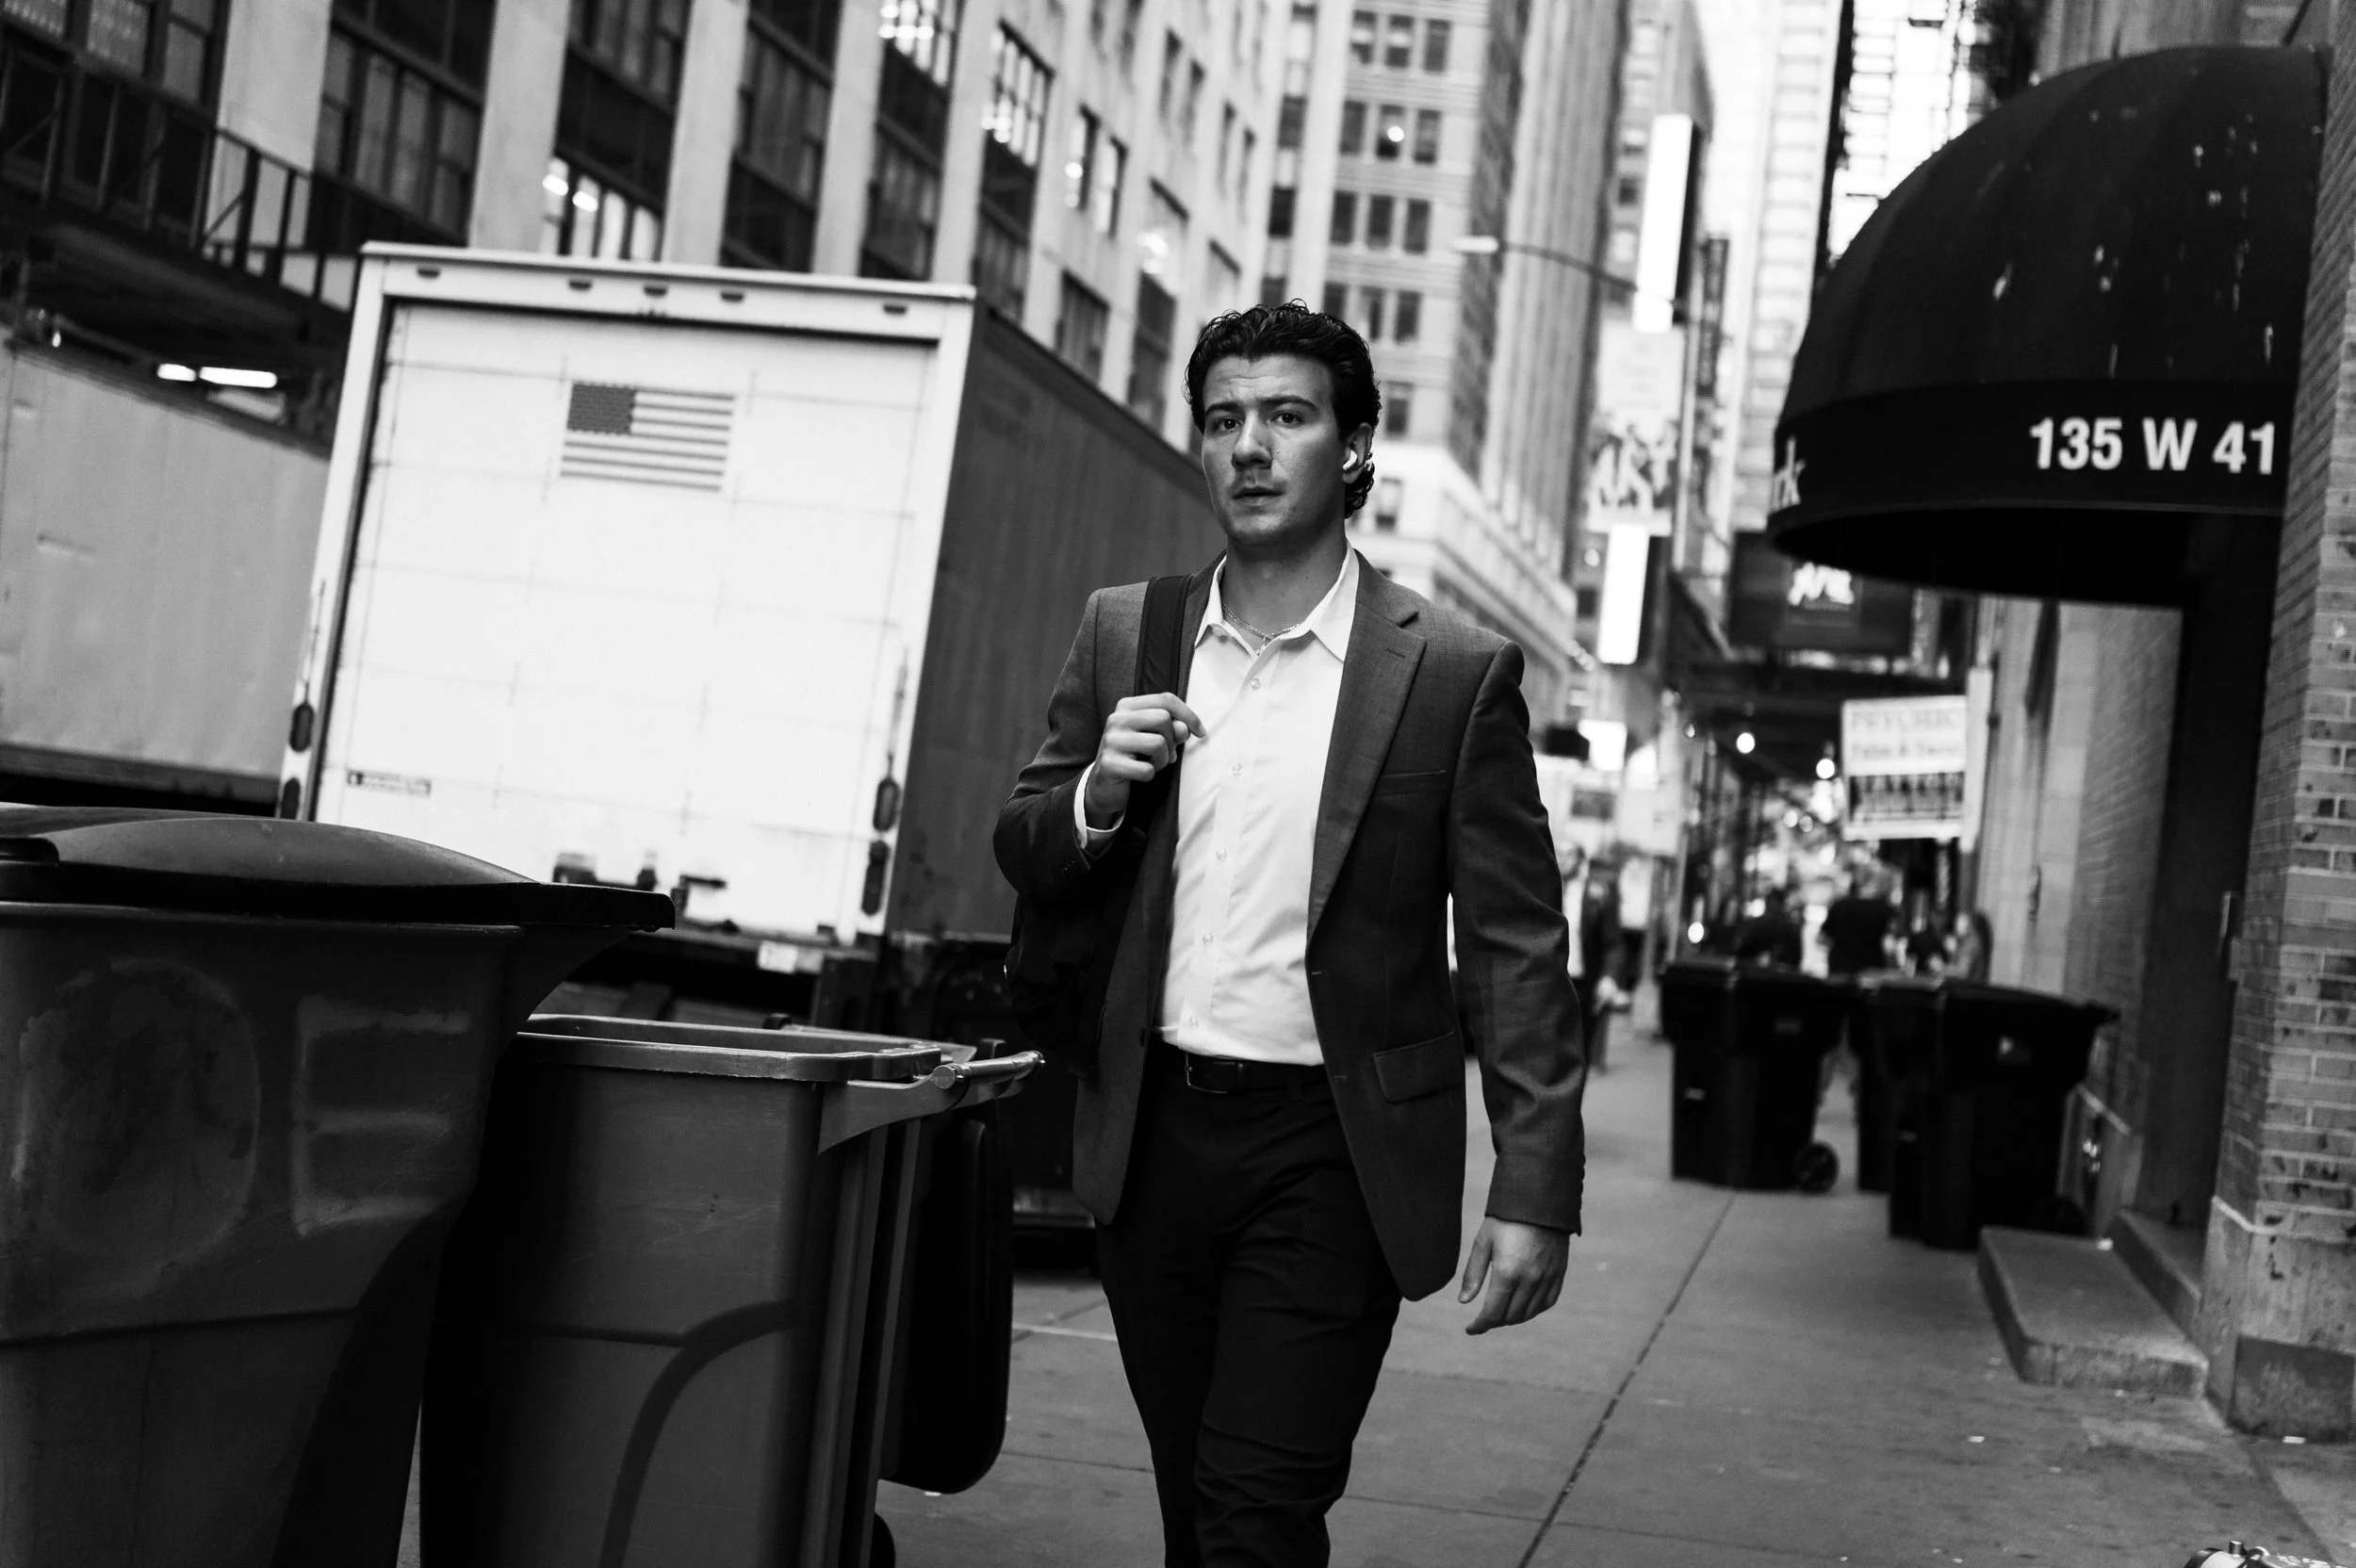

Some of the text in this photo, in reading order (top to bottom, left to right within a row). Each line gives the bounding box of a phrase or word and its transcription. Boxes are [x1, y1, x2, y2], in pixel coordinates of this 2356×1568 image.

[2030, 417, 2276, 475] 135 W 41
